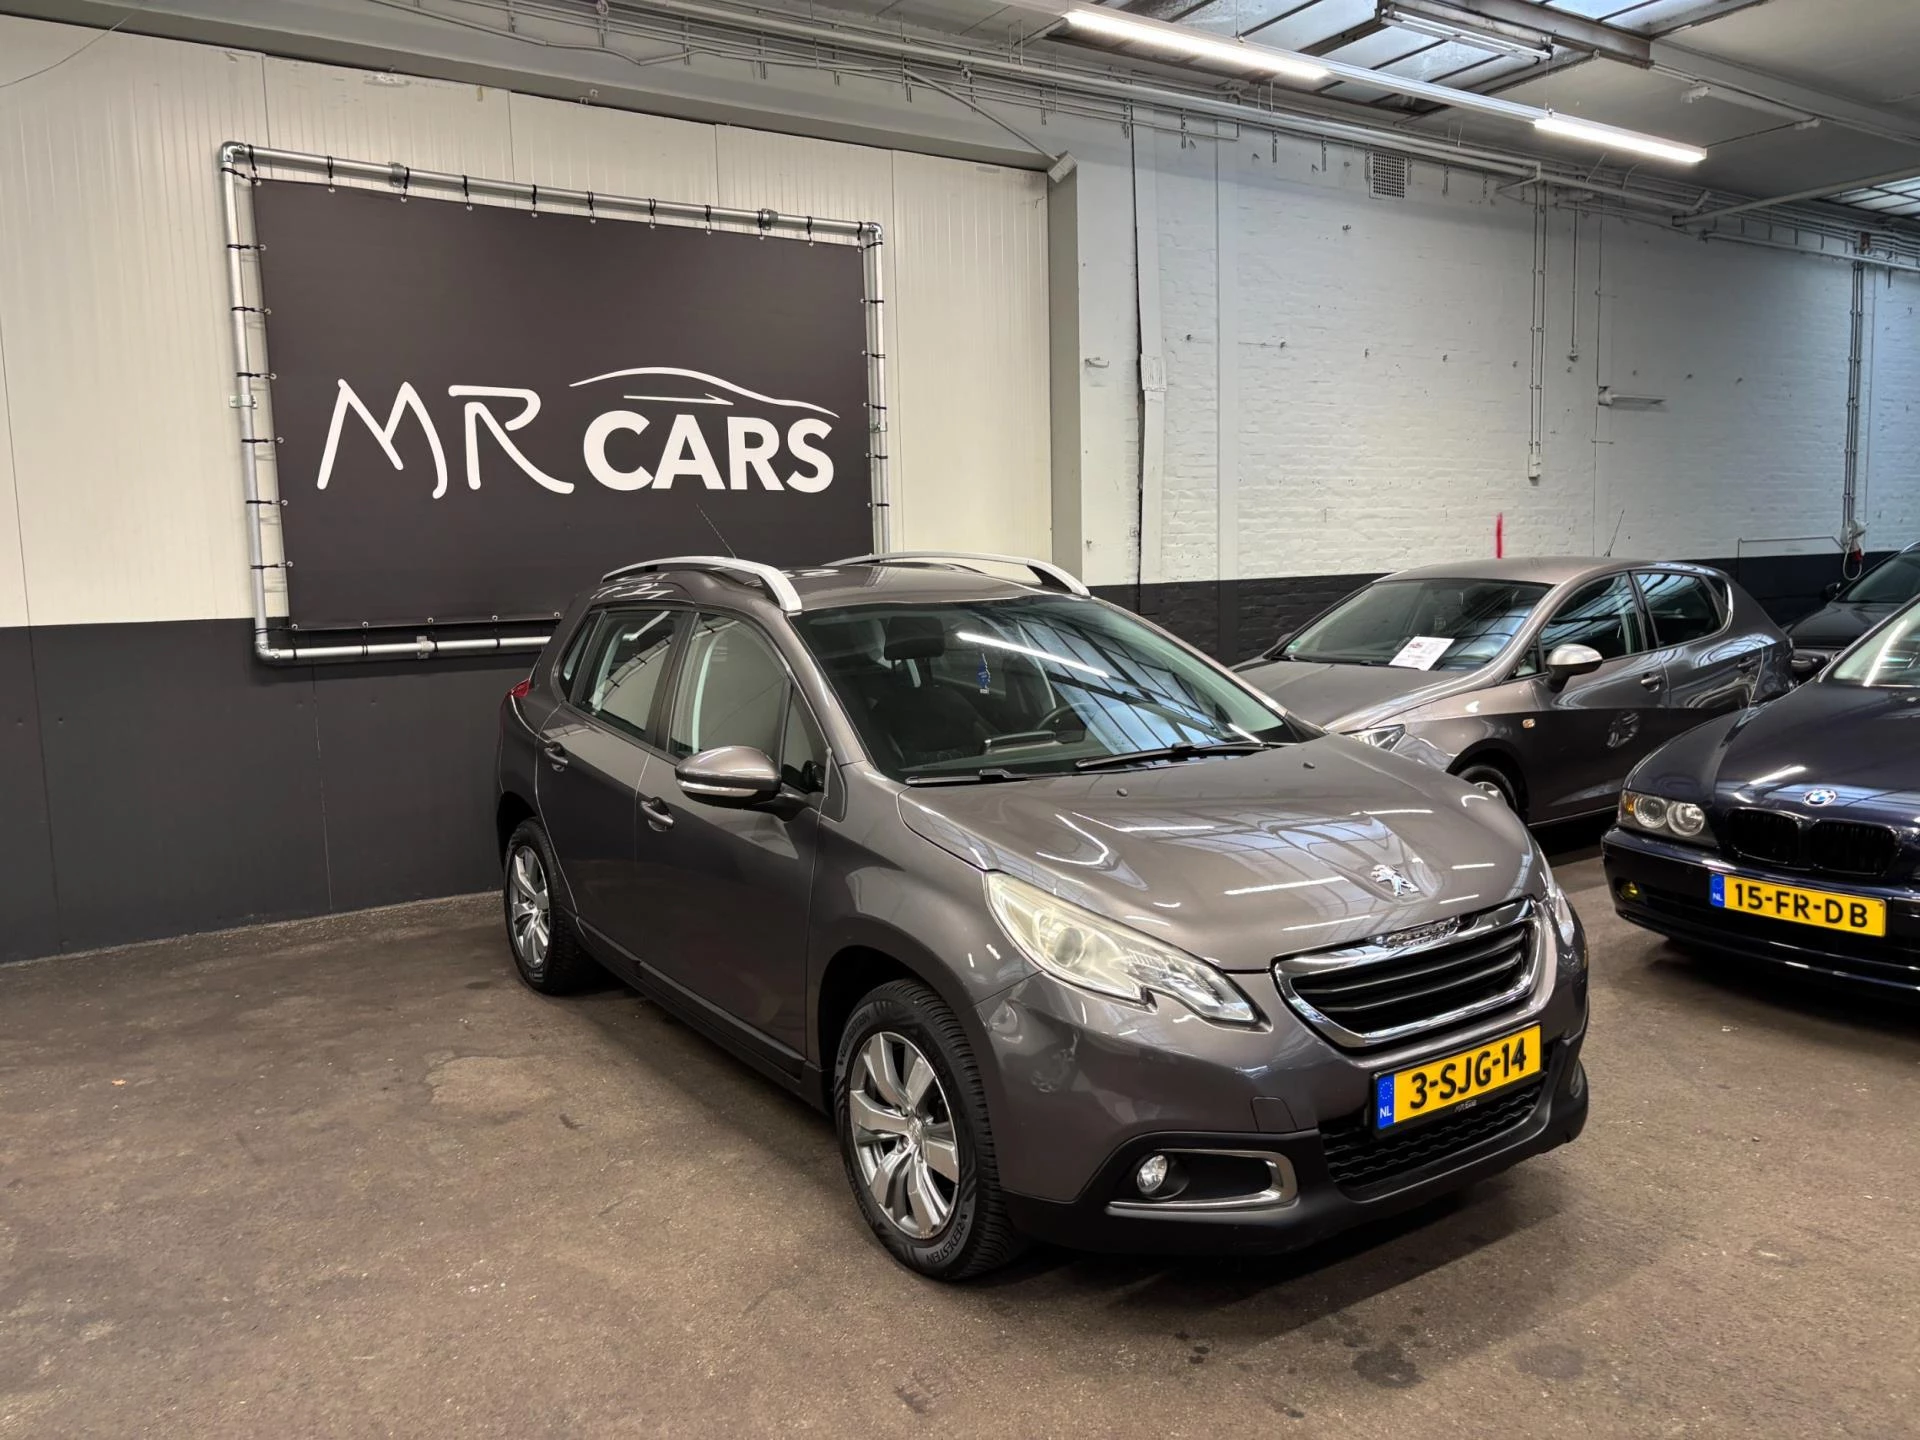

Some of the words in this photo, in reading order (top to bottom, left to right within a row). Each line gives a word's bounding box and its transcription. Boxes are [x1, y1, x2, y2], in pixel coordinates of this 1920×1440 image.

[316, 378, 575, 500] MR
[583, 410, 836, 494] CARS
[1712, 892, 1723, 902] NL
[1734, 883, 1869, 928] 15-FR-DB
[1409, 1037, 1527, 1110] 3-SJG-14
[1379, 1106, 1392, 1119] NL
